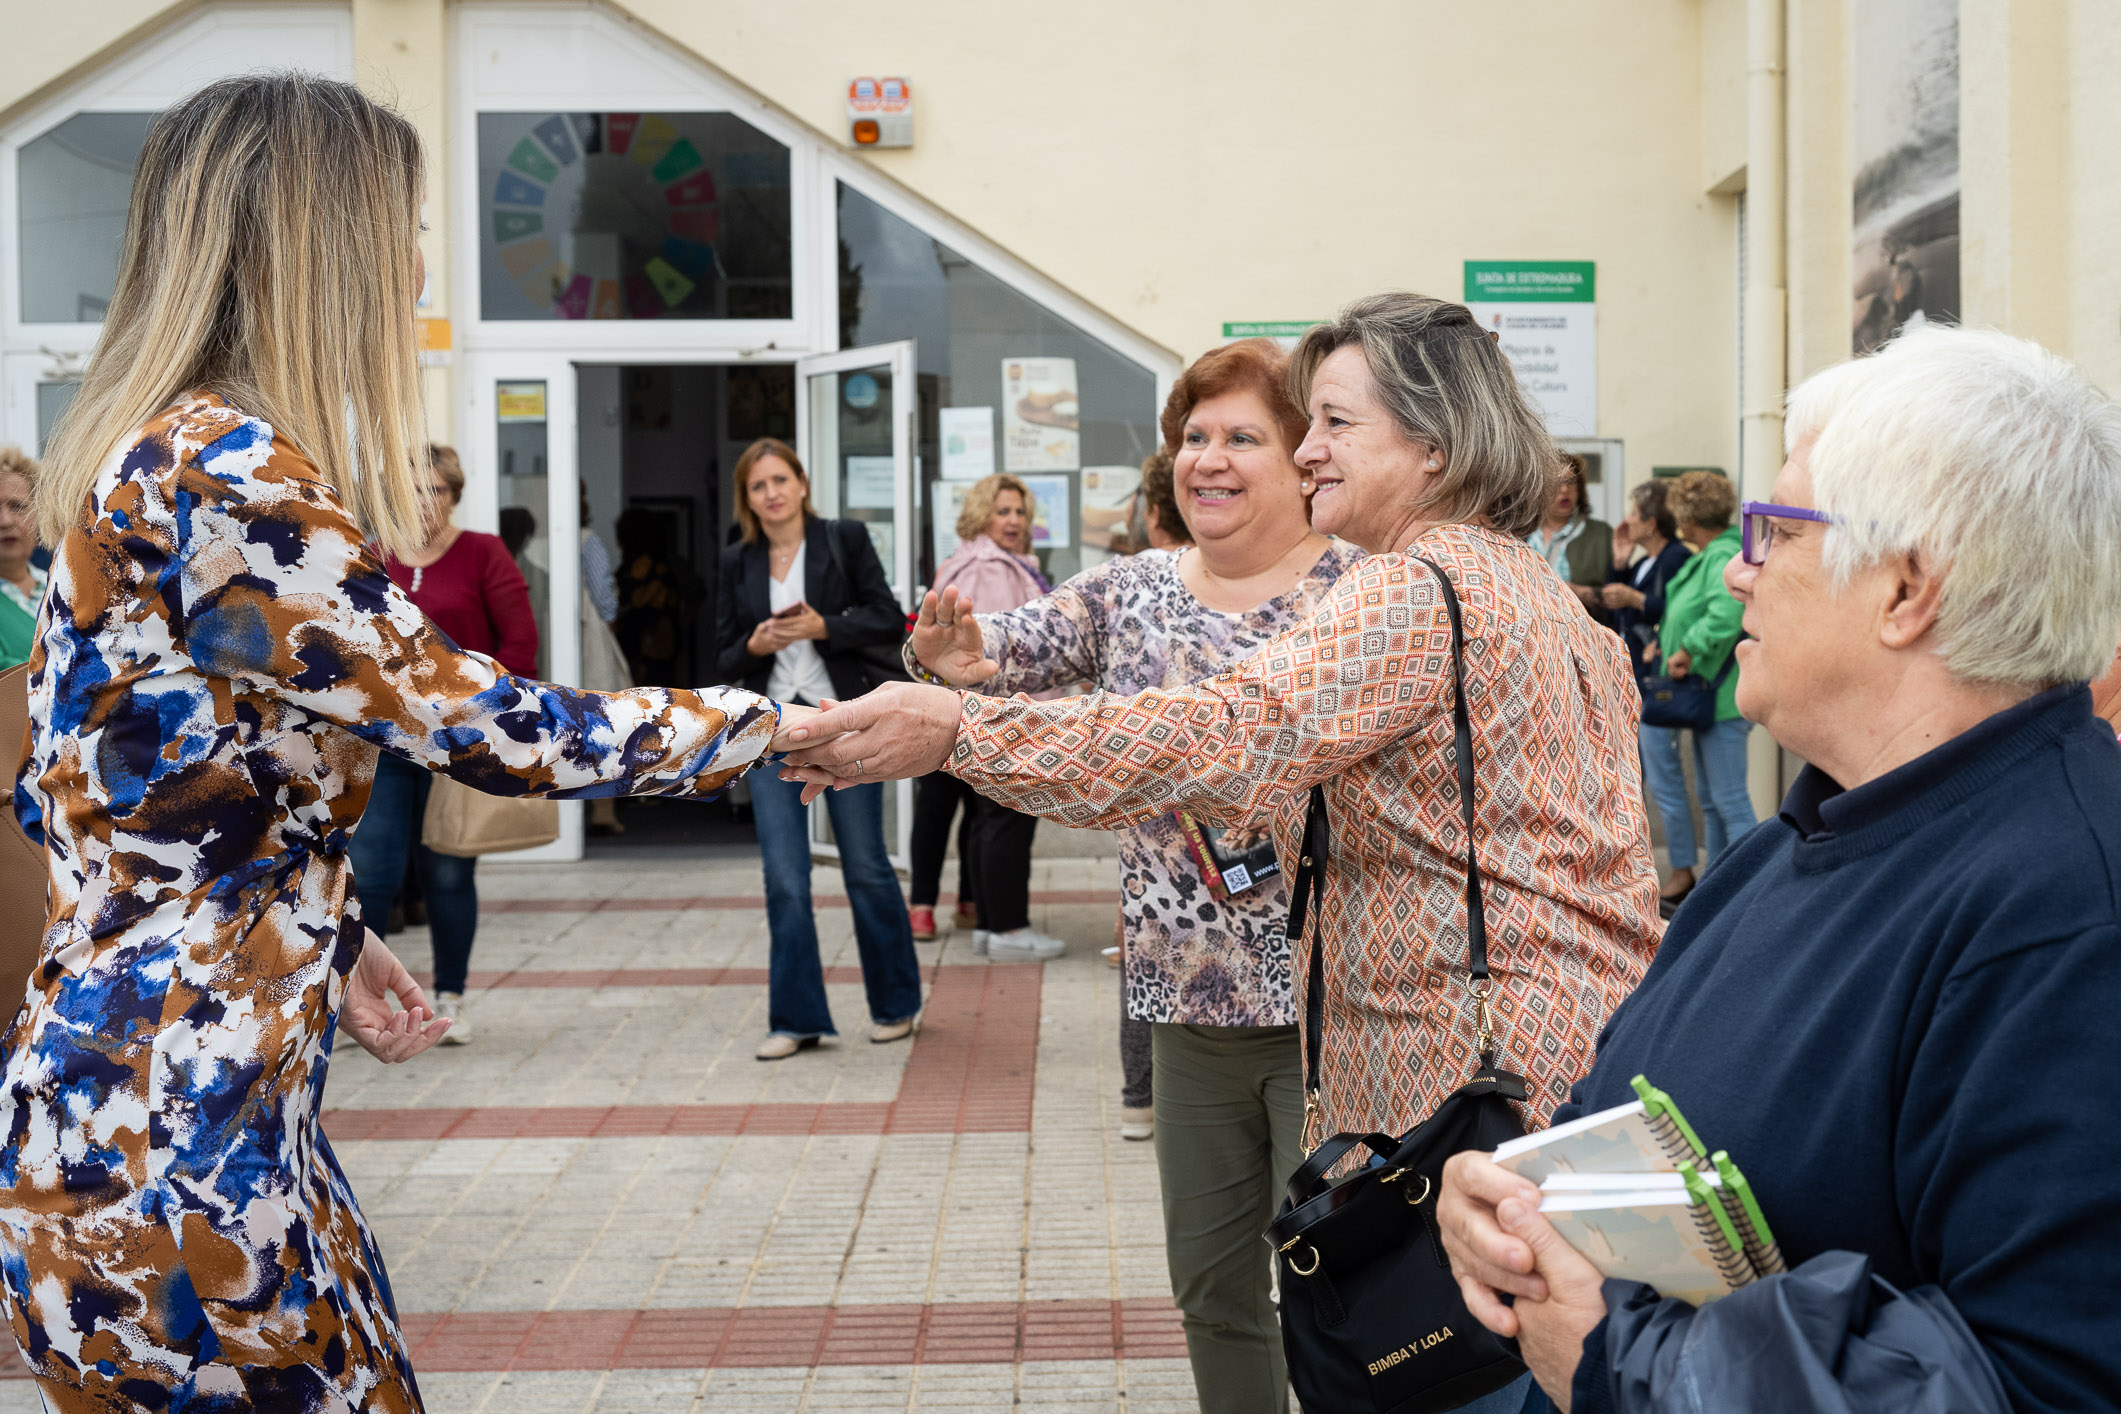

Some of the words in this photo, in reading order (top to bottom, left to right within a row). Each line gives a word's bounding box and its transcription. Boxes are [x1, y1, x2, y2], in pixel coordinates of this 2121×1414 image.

[1192, 832, 1201, 843] en
[1198, 844, 1217, 877] estamos
[1367, 1347, 1411, 1376] BIMBA
[1408, 1341, 1418, 1355] Y
[1420, 1326, 1454, 1350] LOLA
